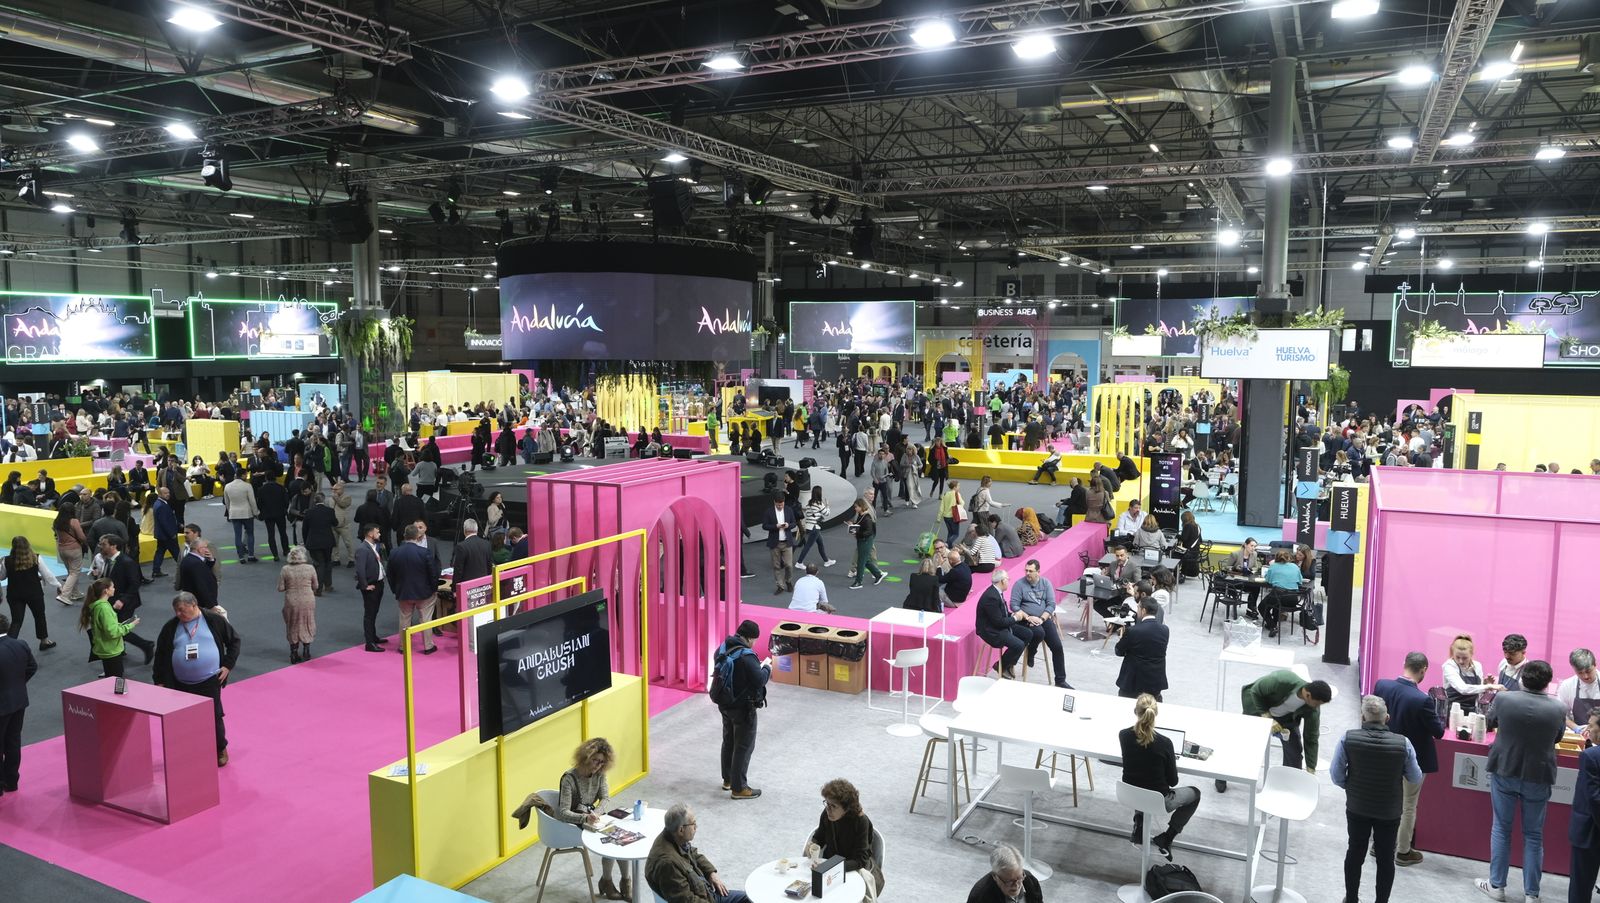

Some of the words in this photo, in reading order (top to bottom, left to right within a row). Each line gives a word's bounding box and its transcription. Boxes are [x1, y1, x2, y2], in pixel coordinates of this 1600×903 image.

[1006, 283, 1016, 297] B
[511, 303, 603, 333] Andalucía
[697, 306, 752, 335] Andalucí
[977, 308, 1013, 317] BUSINESS
[1016, 308, 1037, 316] AREA
[1210, 346, 1249, 357] Huelva
[1275, 346, 1311, 355] HUELVA
[1275, 353, 1316, 362] TURISMO
[1304, 450, 1313, 477] PROVINCIA
[1340, 489, 1350, 520] HUELVA
[517, 633, 591, 674] ANDALUSIAN
[536, 653, 576, 680] CRUSH
